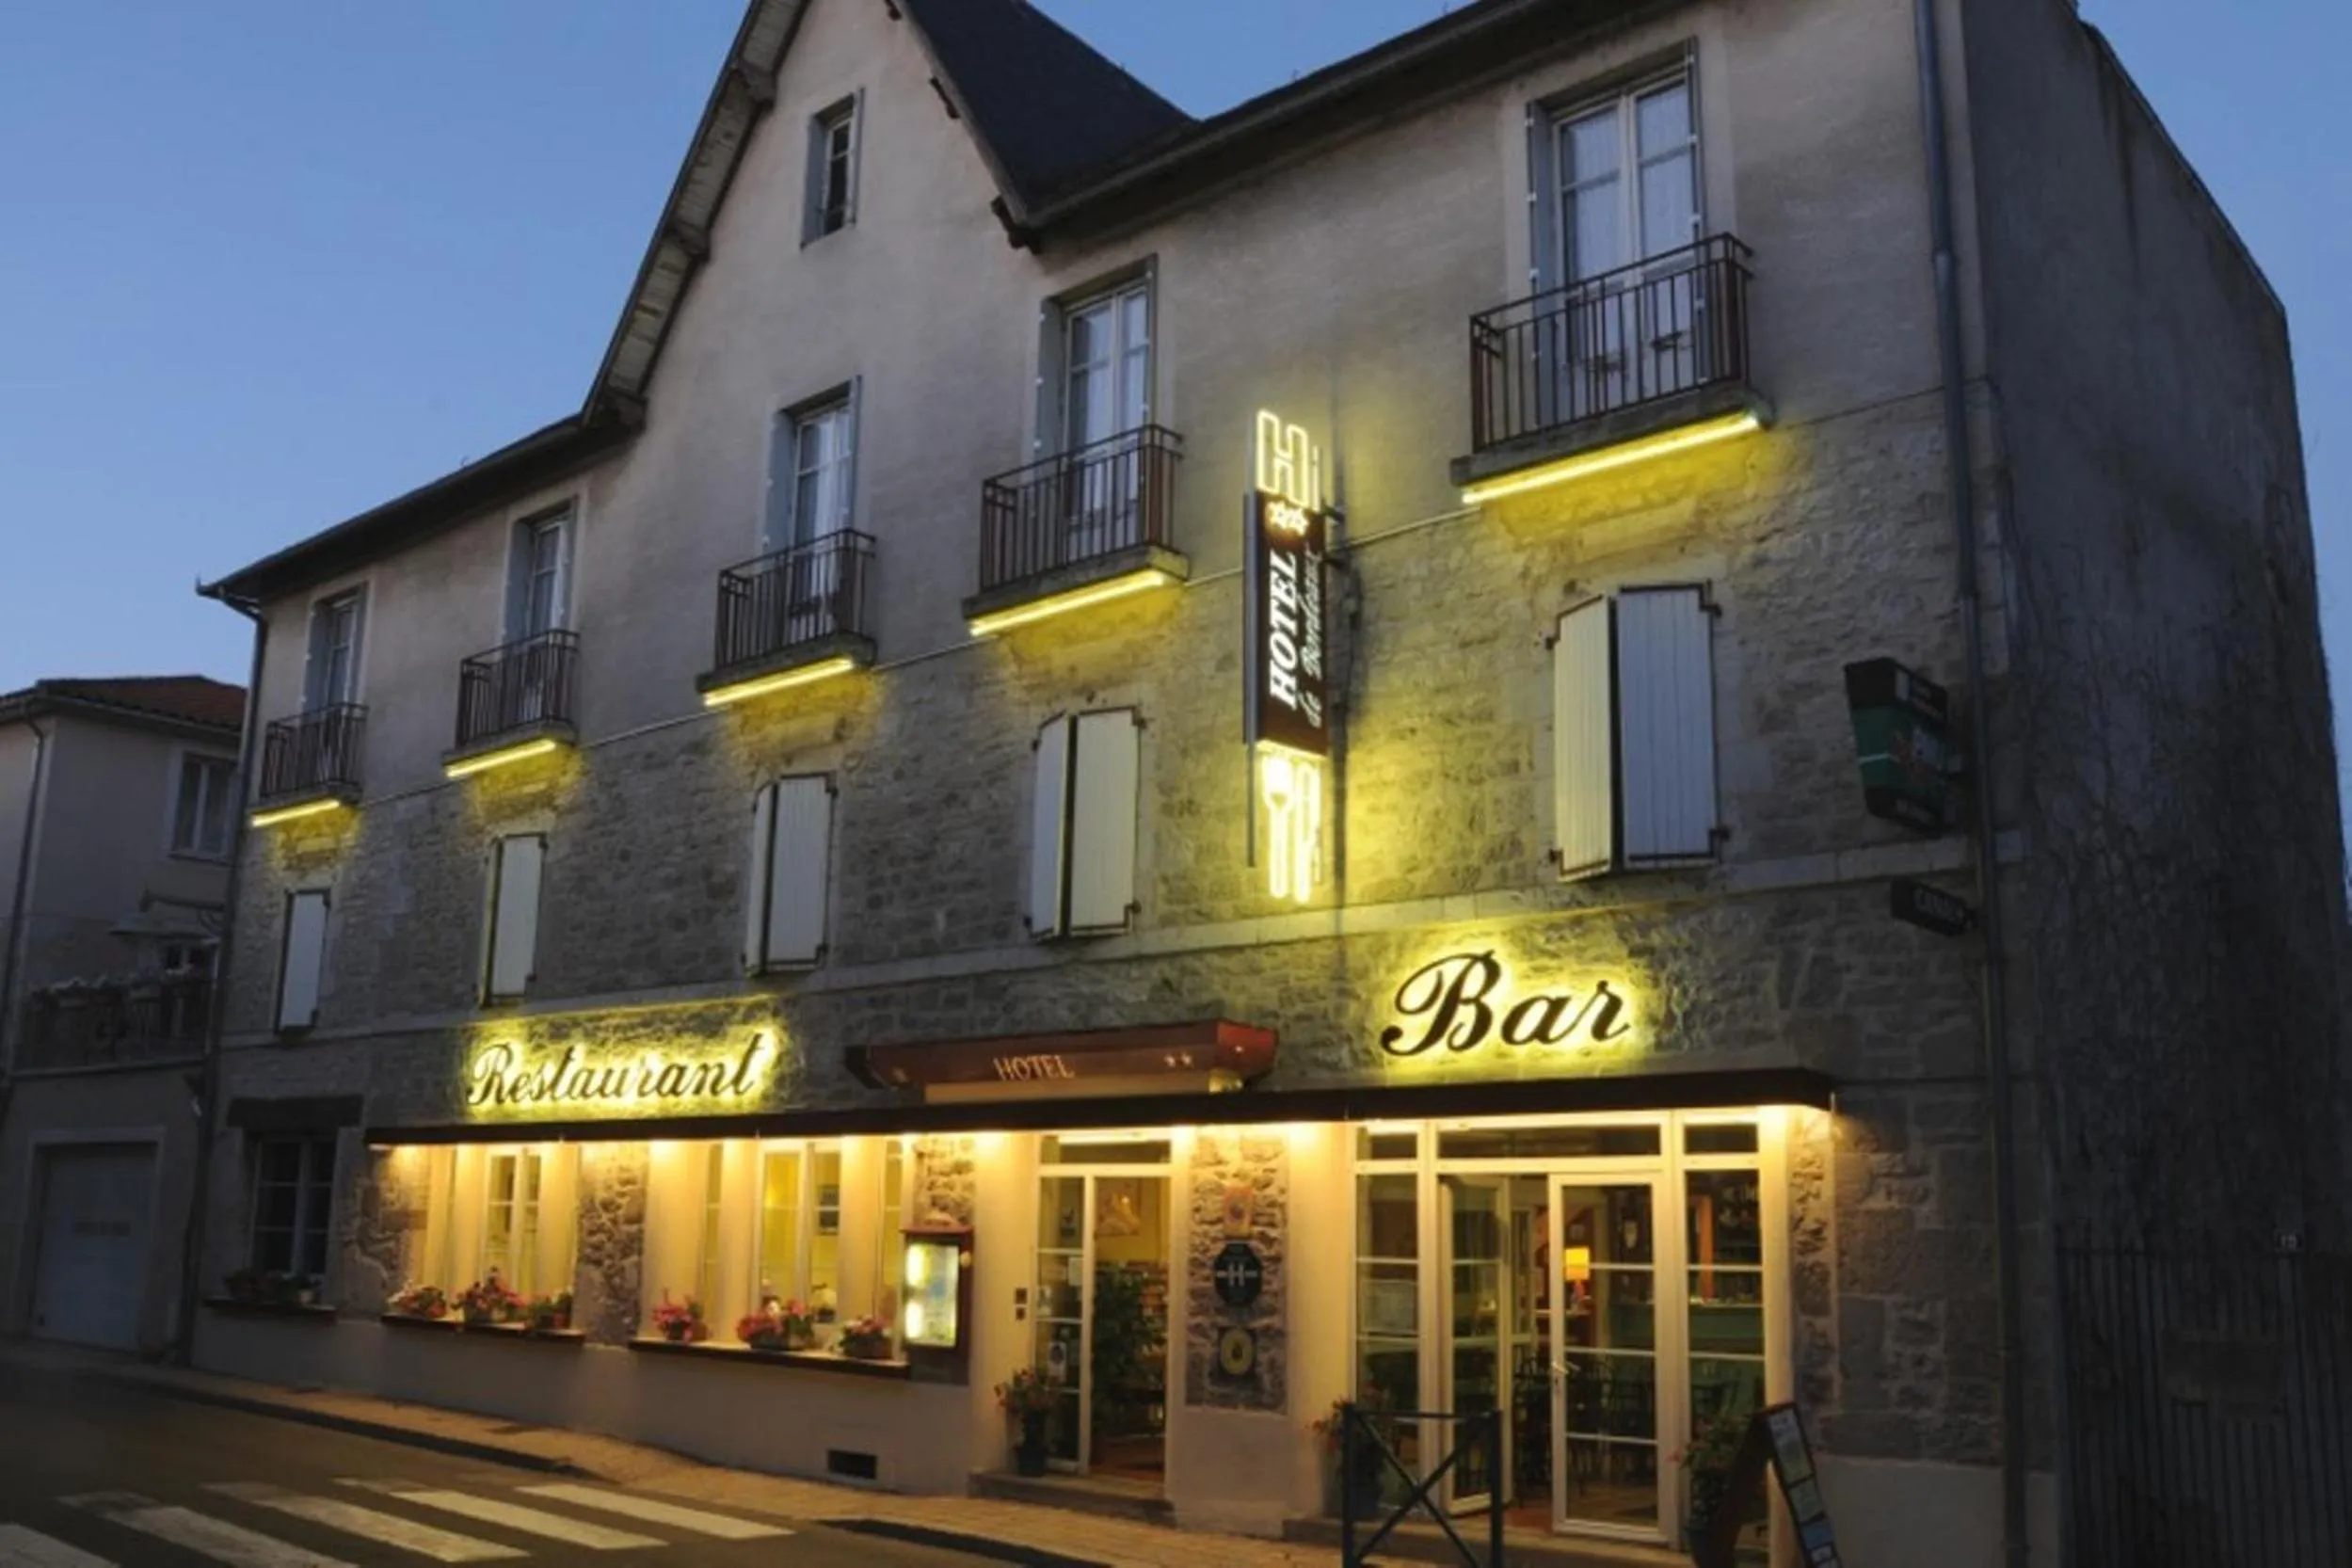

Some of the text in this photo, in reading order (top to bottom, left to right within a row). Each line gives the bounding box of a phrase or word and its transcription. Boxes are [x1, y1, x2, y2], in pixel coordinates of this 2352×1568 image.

[1270, 550, 1297, 710] HOTEL
[1381, 949, 1630, 1056] Bar
[468, 1032, 766, 1107] Restaurant
[994, 1054, 1075, 1081] HOTEL
